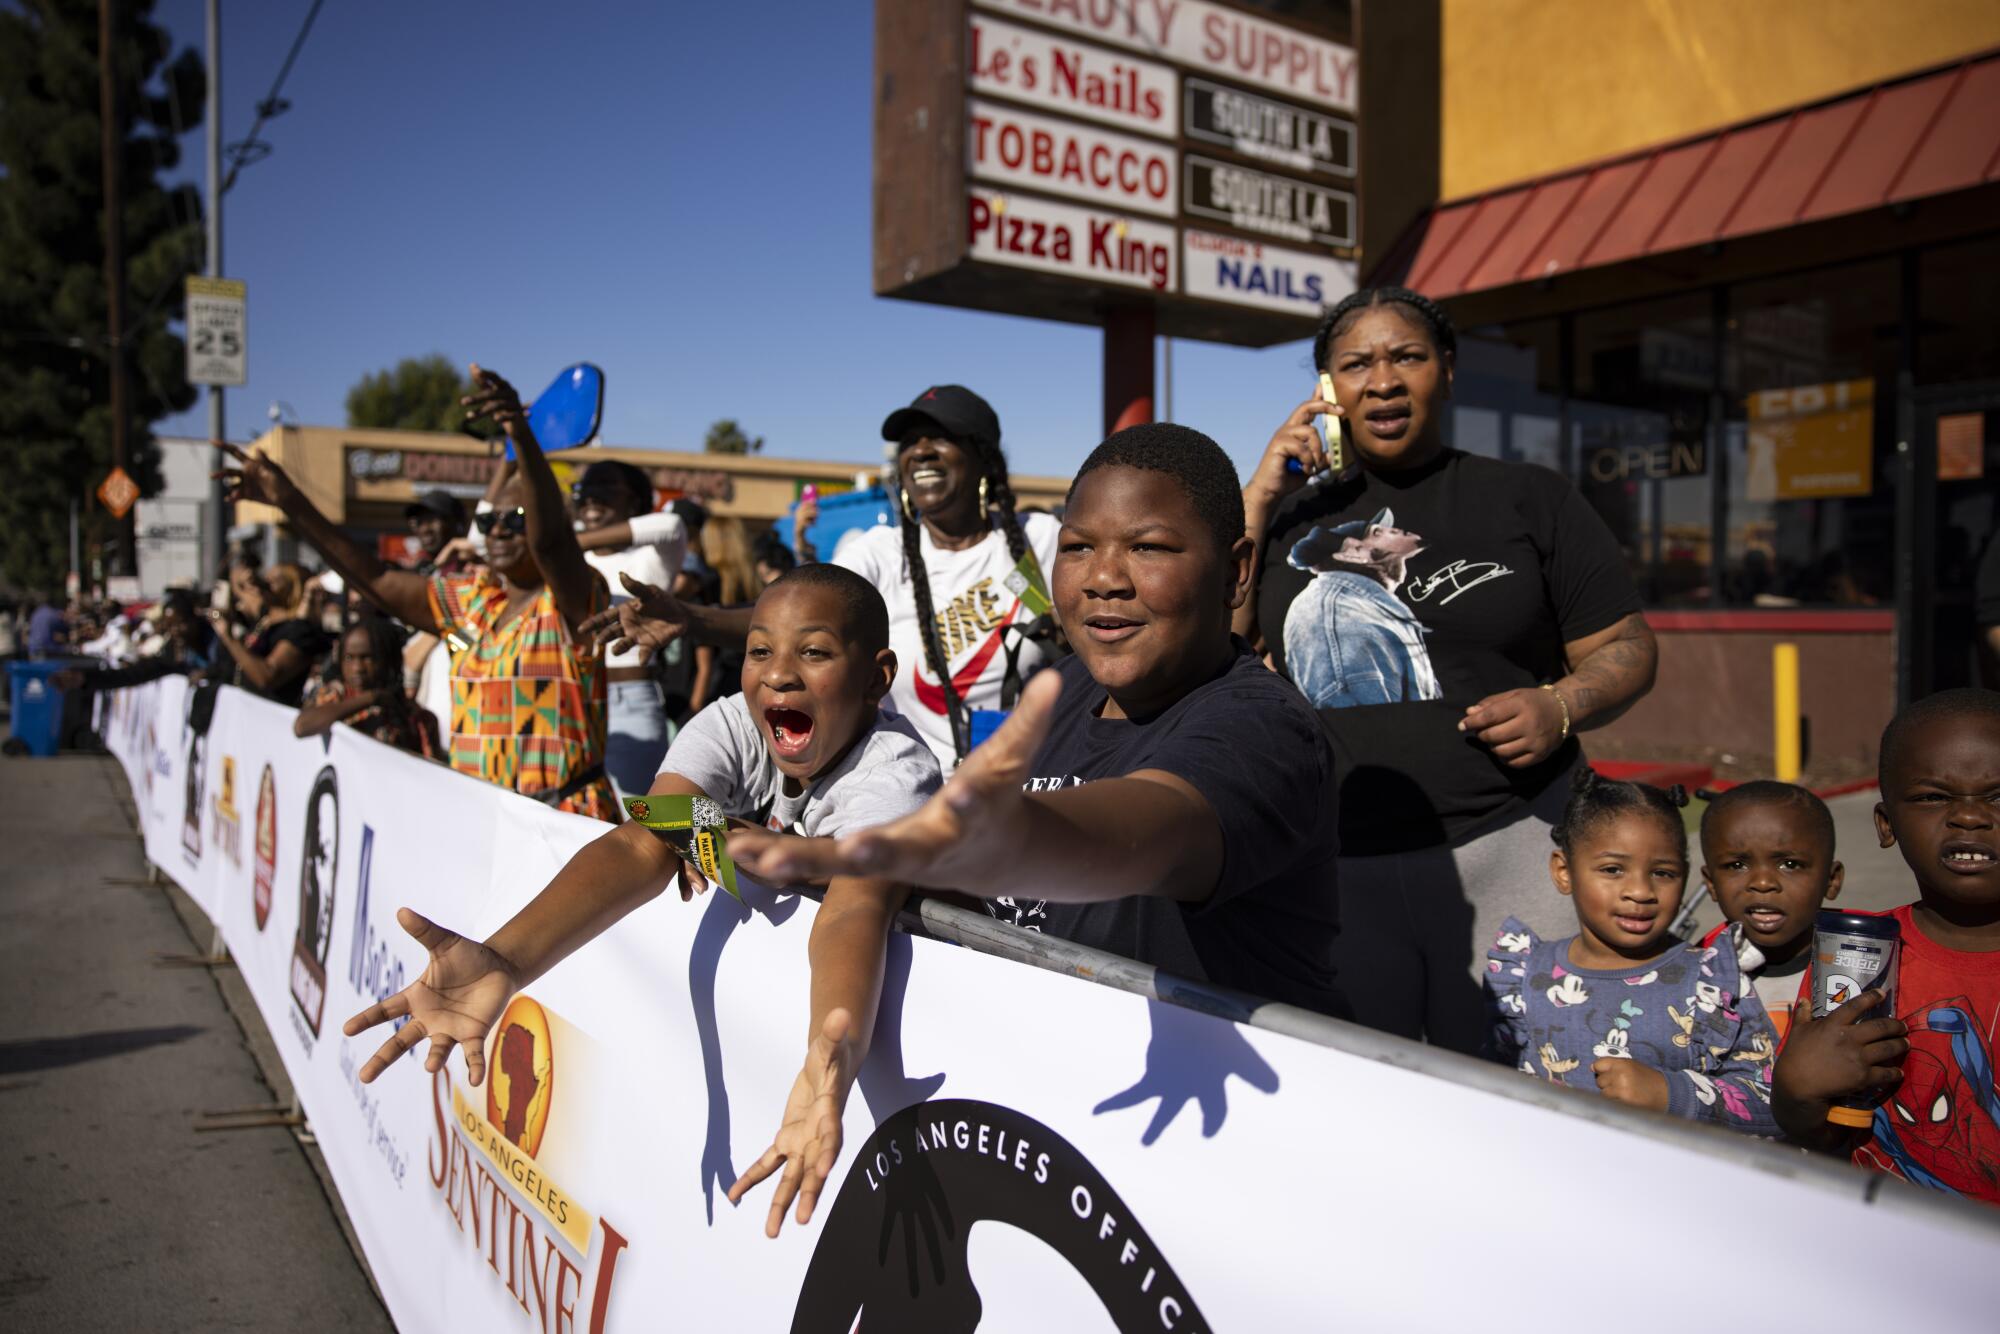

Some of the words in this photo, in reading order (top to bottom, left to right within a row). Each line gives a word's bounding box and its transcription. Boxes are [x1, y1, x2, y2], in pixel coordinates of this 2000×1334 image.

[969, 26, 1037, 89] Le's
[1051, 49, 1163, 120] Nails
[1202, 11, 1355, 99] SUPPLY
[971, 116, 1169, 199] TOBACCO
[1297, 113, 1333, 160] LA
[1296, 187, 1332, 232] LA
[969, 195, 1073, 262] Pizza
[1089, 217, 1169, 291] King
[1217, 258, 1325, 303] NAILS
[194, 329, 241, 358] 25
[1590, 440, 1704, 483] OPEN
[701, 837, 711, 857] MAKE
[1833, 955, 1880, 971] FIERCE
[460, 1102, 485, 1143] LOS
[489, 1136, 570, 1225] ANGELES
[865, 1138, 904, 1191] LOS
[915, 1119, 1051, 1184] ANGELES
[1070, 1185, 1184, 1330] OFFIC
